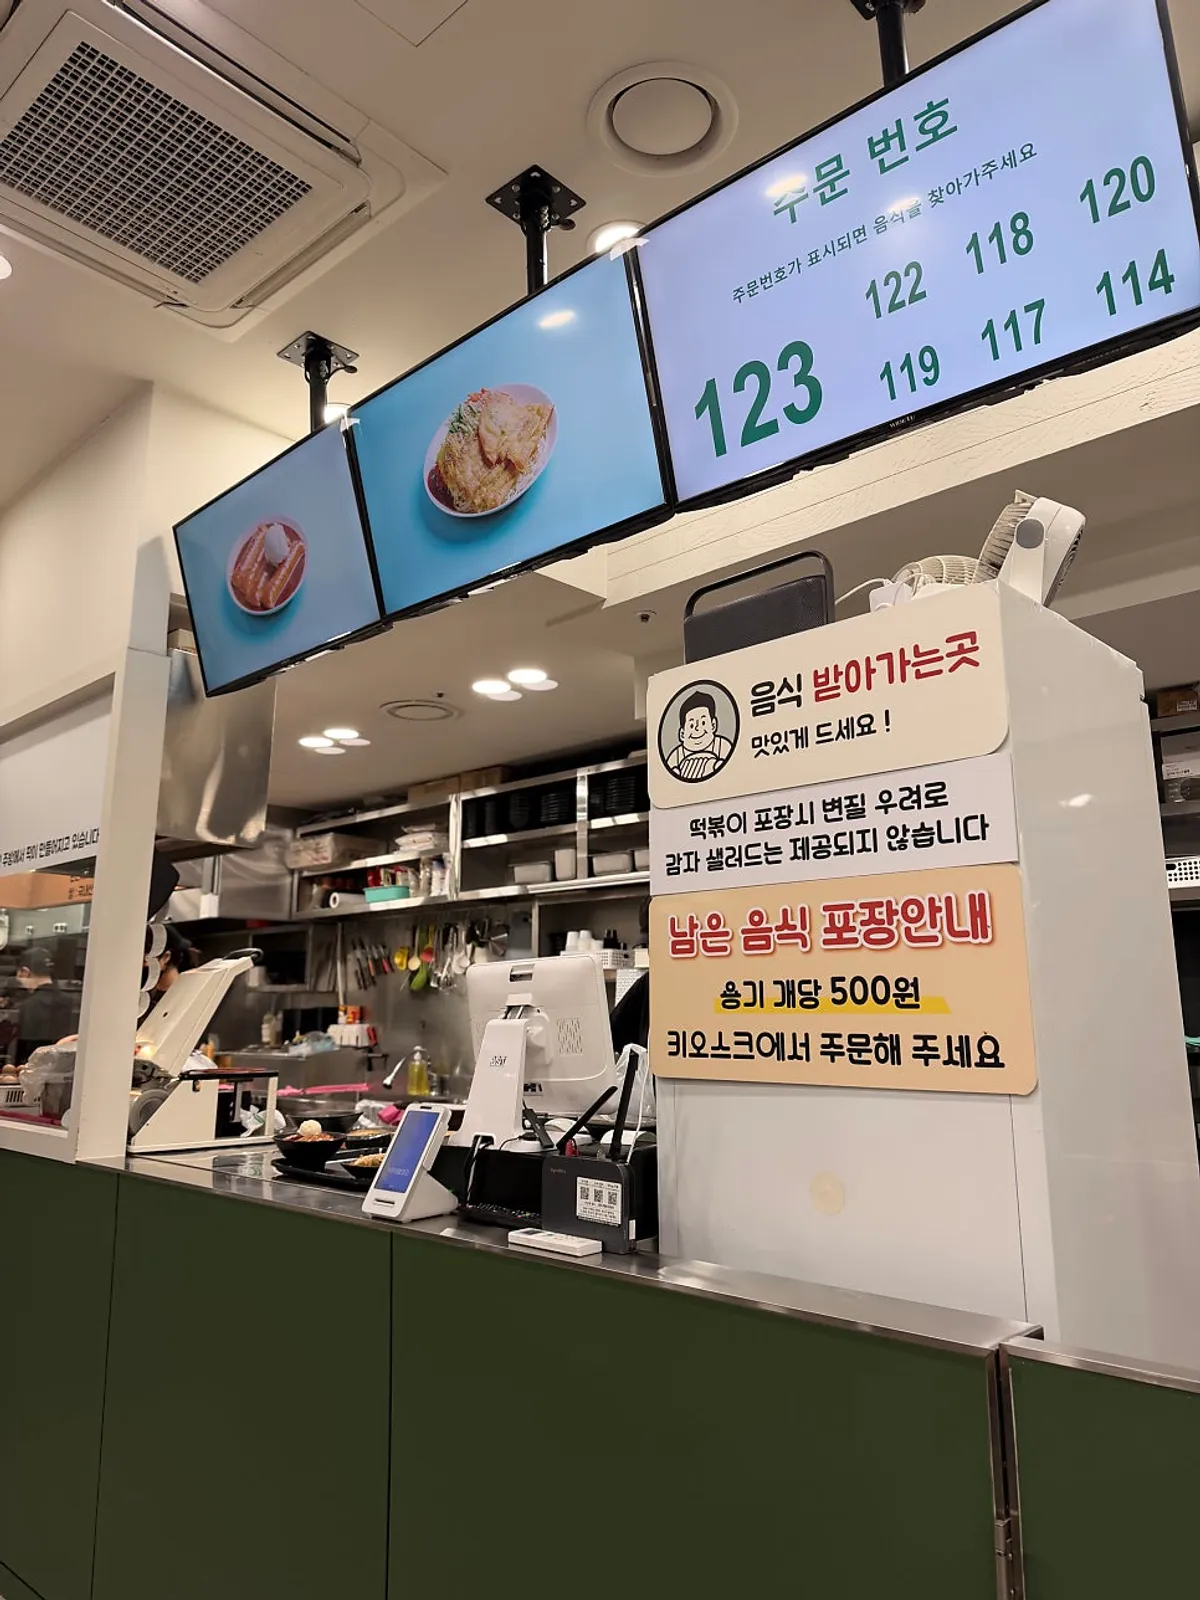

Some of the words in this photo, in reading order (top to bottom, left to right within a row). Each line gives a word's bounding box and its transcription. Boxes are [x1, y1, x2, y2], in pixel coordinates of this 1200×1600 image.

[773, 154, 851, 224] 주문
[866, 97, 958, 175] 번호
[732, 258, 802, 304] 주문번호가
[807, 225, 867, 268] 표시되면
[873, 198, 922, 235] 음식을
[927, 142, 1037, 208] 찾아가주세요
[865, 261, 927, 319] 122
[965, 212, 1034, 275] 118
[1079, 155, 1156, 224] 120
[879, 345, 940, 401] 119
[981, 298, 1045, 361] 117
[1096, 249, 1175, 316] 114
[694, 340, 823, 458] 123
[750, 673, 803, 718] 음식
[812, 630, 981, 703] 받아가는곳
[751, 725, 809, 759] 맛있게
[814, 713, 877, 745] 드세요
[665, 851, 701, 877] 감자
[706, 840, 784, 873] 샐러드는
[789, 827, 878, 862] 제공되지
[885, 813, 991, 852] 않습니다
[689, 811, 748, 840] 떡볶이
[754, 800, 815, 832] 포장시
[822, 793, 867, 824] 변질
[874, 780, 950, 816] 우려로
[669, 912, 732, 957] 남은
[740, 905, 810, 953] 음식
[821, 891, 992, 949] 포장안내
[720, 980, 764, 1010] 용기
[772, 978, 823, 1010] 개당
[830, 974, 922, 1010] 500원
[666, 1029, 811, 1063] 키오스크에서
[820, 1032, 901, 1067] 주문해
[911, 1033, 1006, 1069] 주세요
